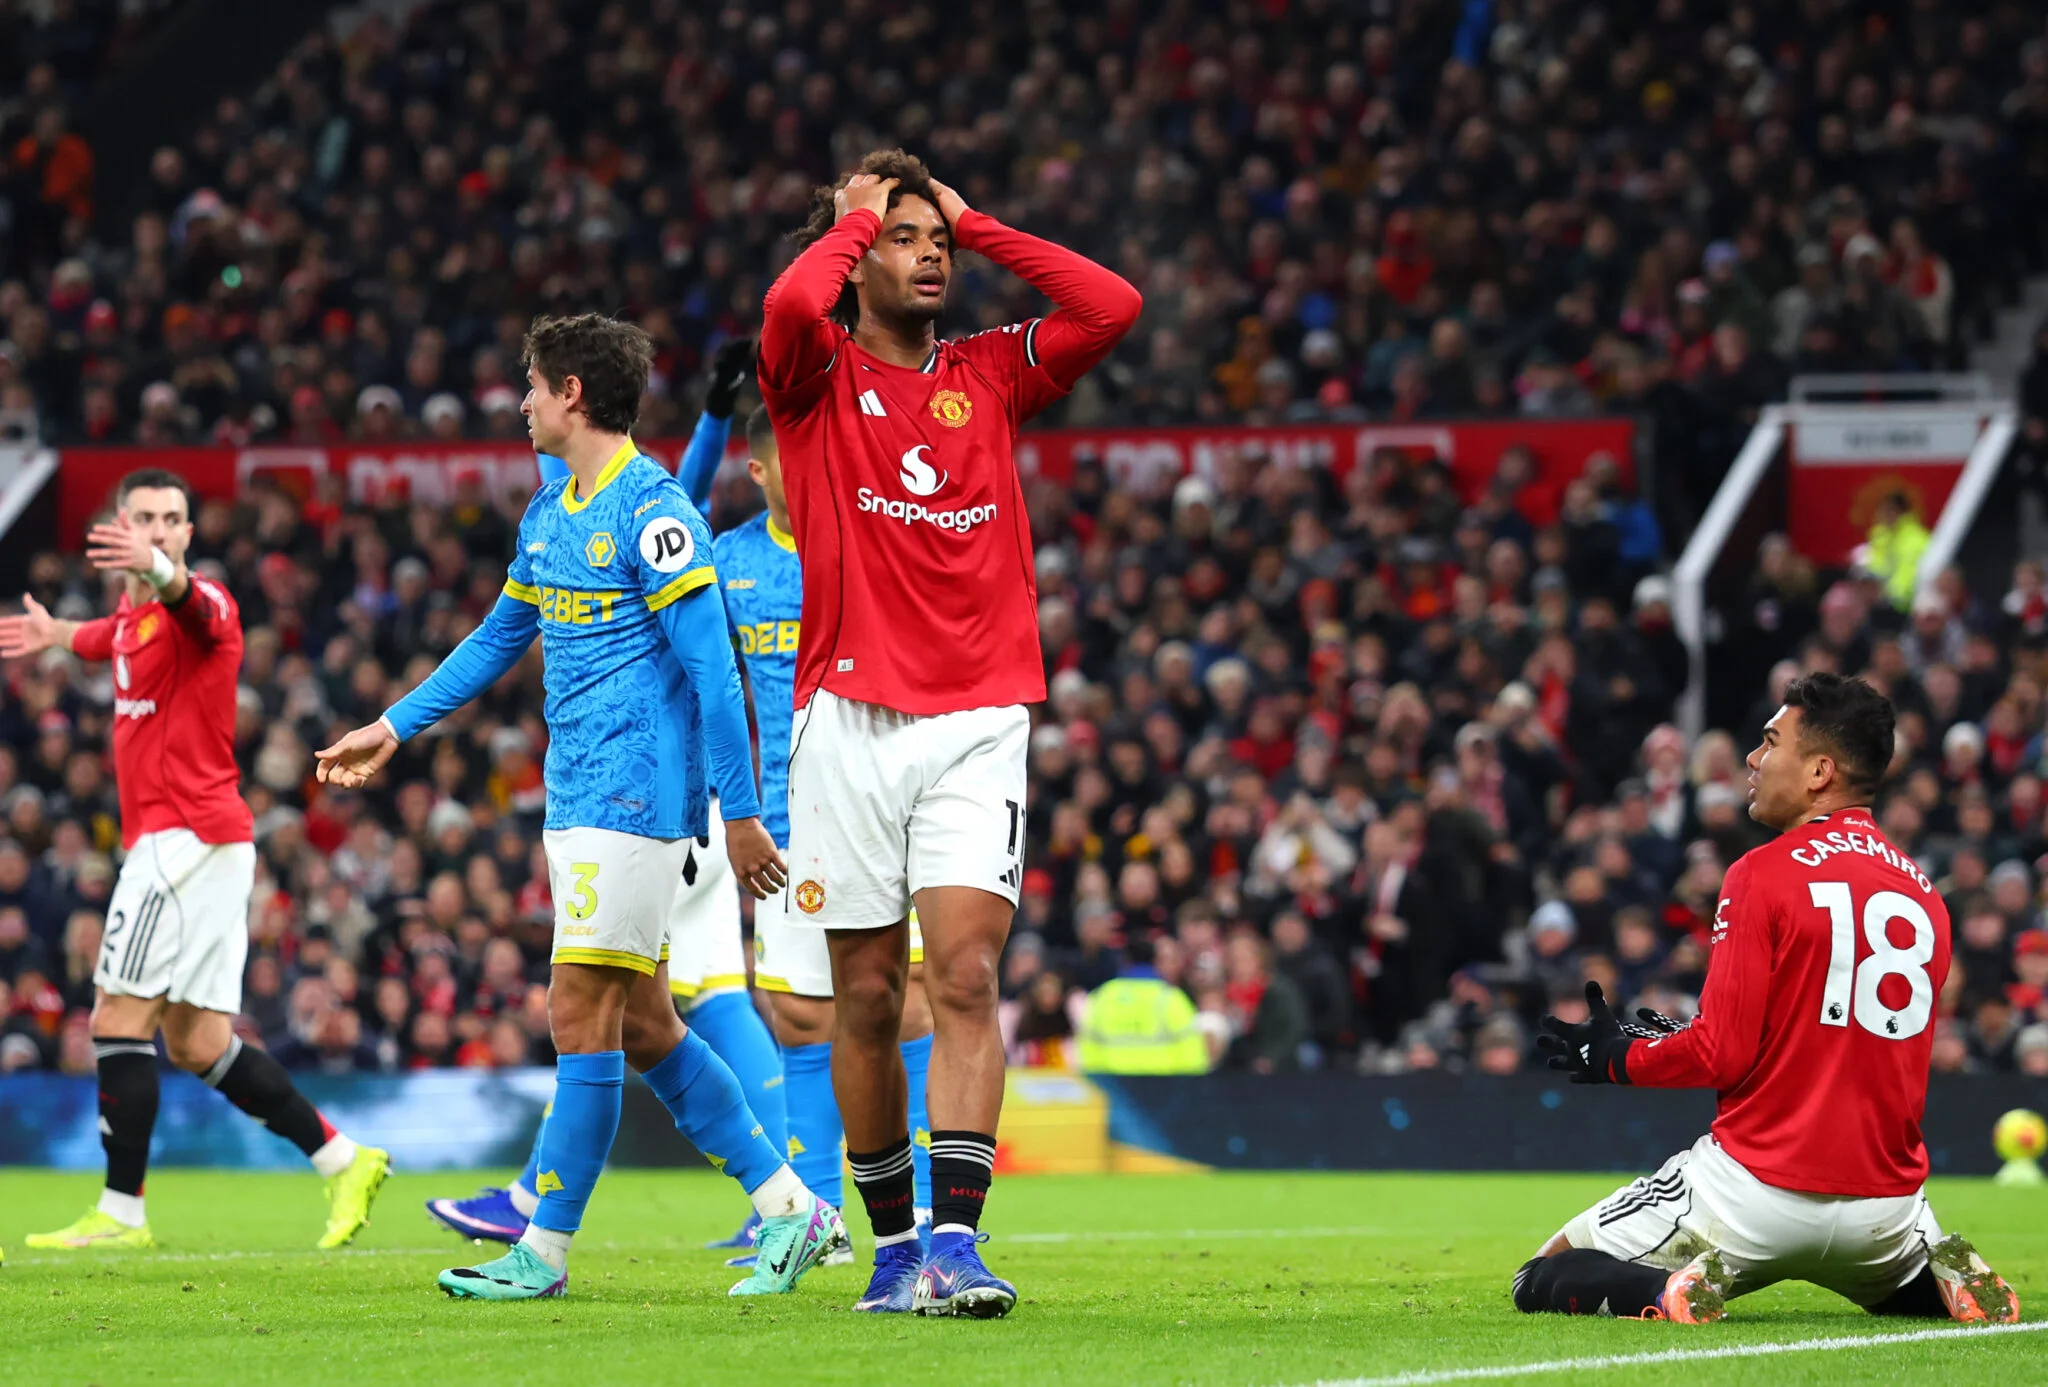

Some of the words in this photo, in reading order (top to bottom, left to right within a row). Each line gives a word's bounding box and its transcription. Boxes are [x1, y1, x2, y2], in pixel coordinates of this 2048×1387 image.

[654, 527, 686, 565] JD
[565, 862, 600, 921] 3
[1791, 831, 1932, 894] CASEMIRO
[1808, 881, 1936, 1040] 18
